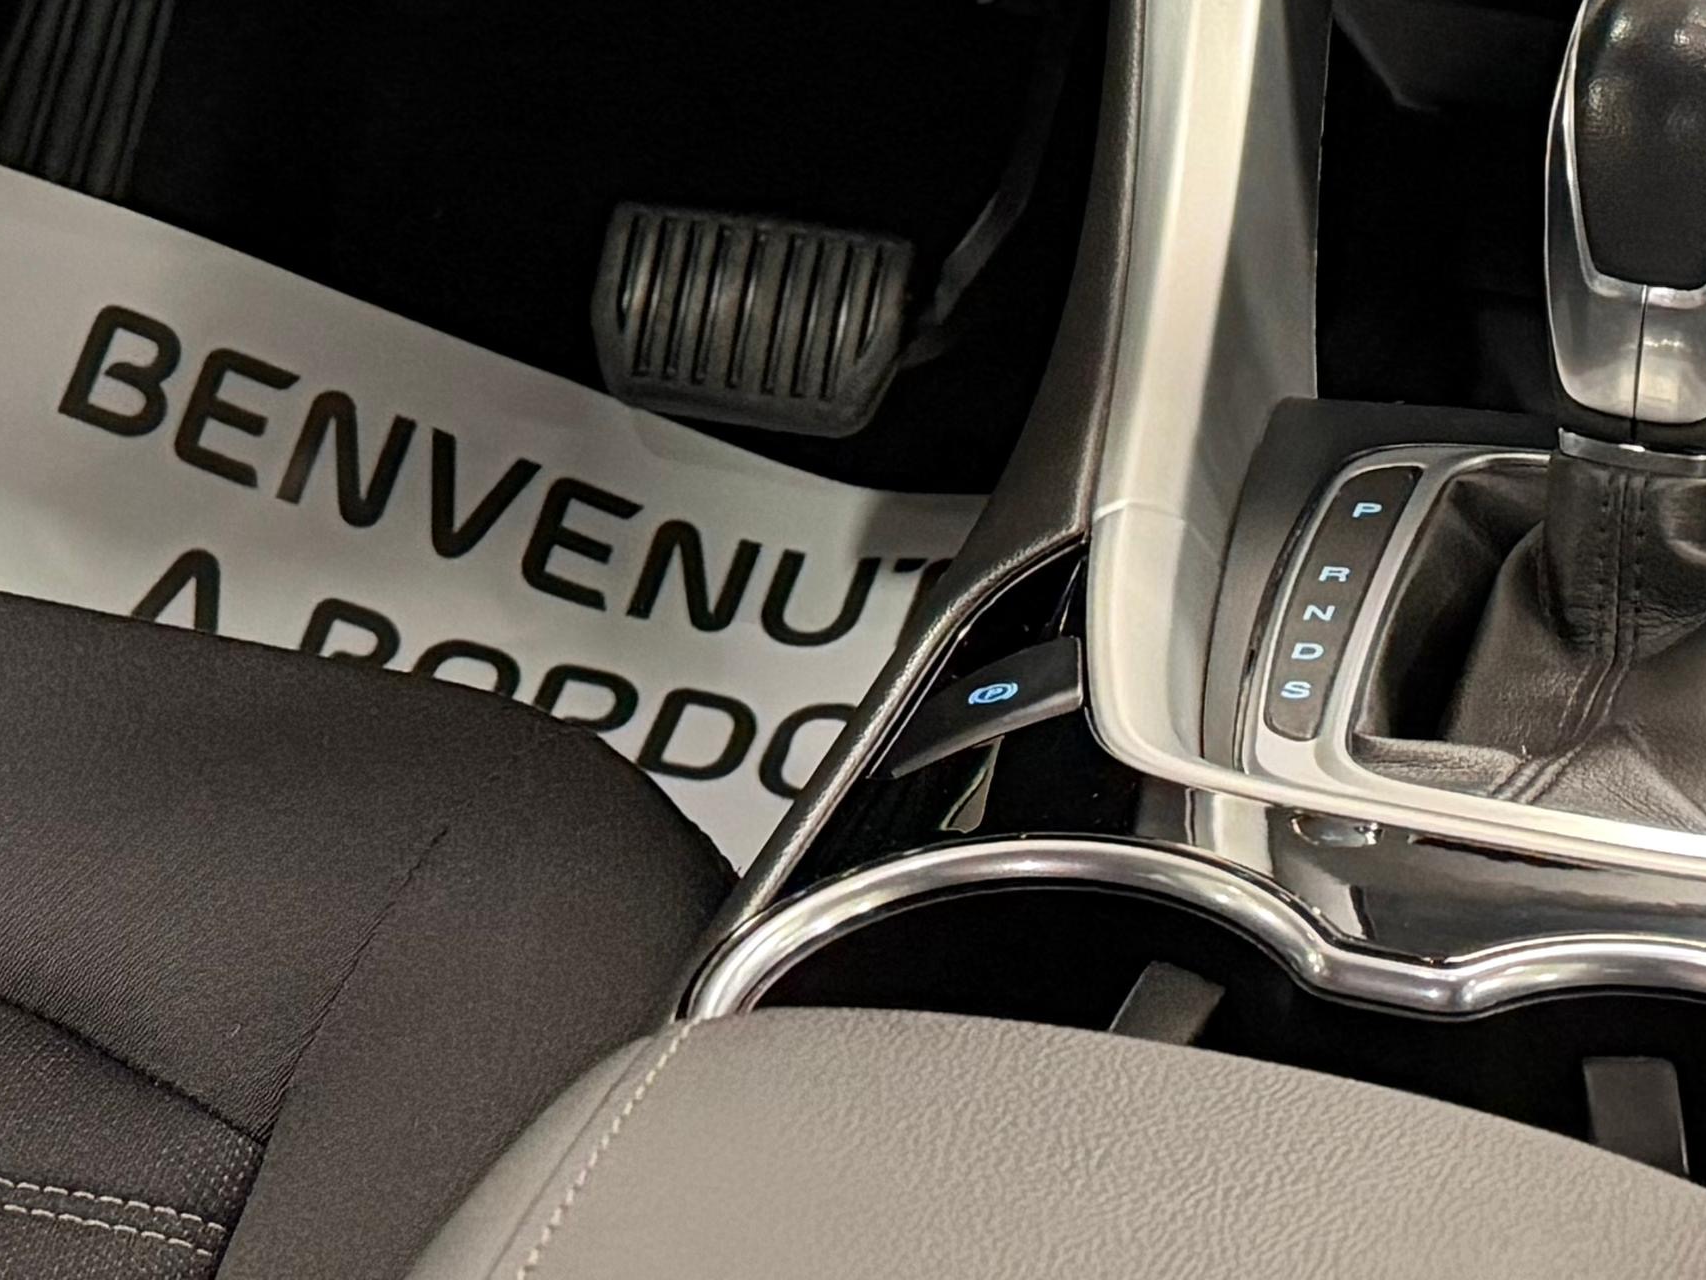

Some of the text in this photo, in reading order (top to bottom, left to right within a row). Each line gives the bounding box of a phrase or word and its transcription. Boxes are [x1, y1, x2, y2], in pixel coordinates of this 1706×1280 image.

[58, 304, 953, 648] BENVENU
[1352, 502, 1382, 519] P
[1318, 565, 1350, 582] R
[131, 548, 220, 635] A
[1303, 604, 1335, 622] N
[1291, 643, 1324, 660] D
[1280, 680, 1312, 699] S
